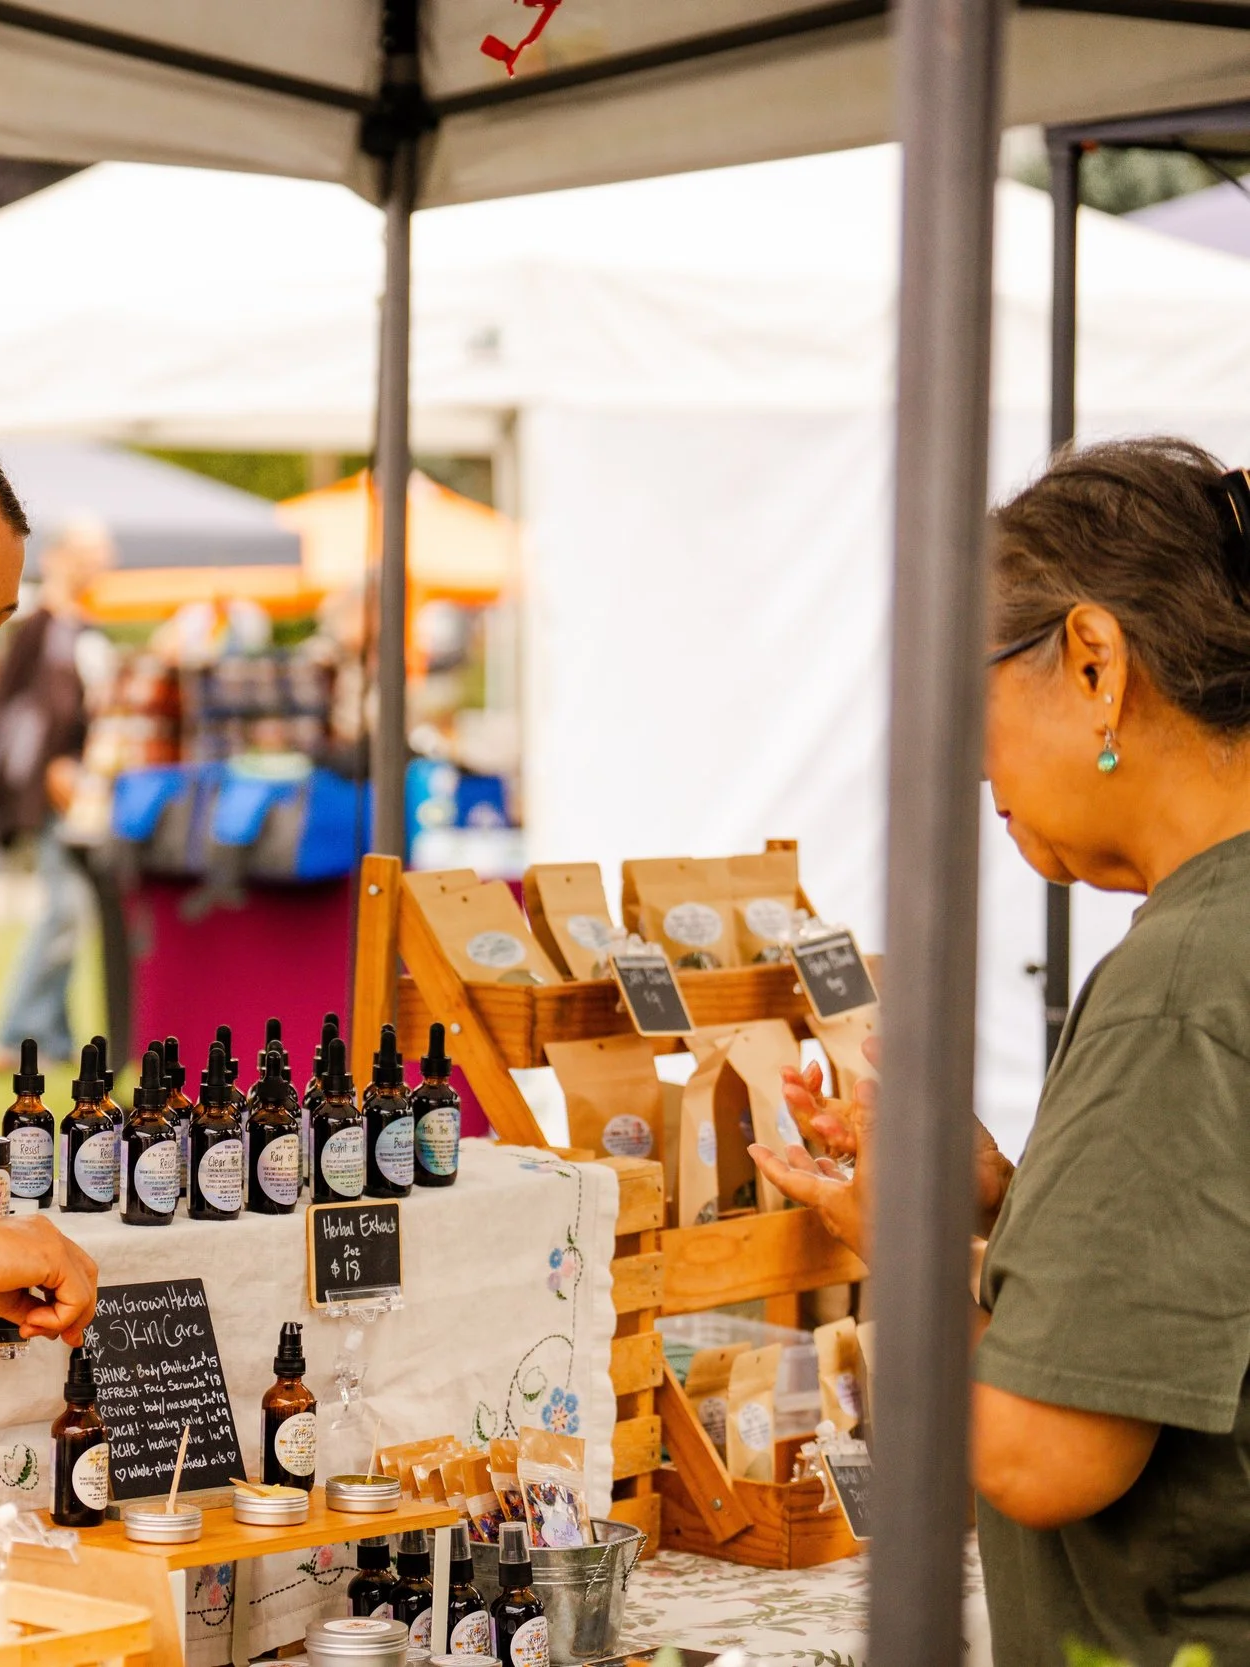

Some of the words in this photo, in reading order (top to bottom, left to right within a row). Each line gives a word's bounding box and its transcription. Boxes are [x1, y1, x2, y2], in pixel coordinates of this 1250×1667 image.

[20, 1144, 40, 1155] Resist
[323, 1215, 355, 1239] Herbal
[343, 1244, 361, 1258] 2oz
[95, 1293, 168, 1317] RM-Grown
[167, 1285, 206, 1311] Herbal
[163, 1314, 205, 1347] Care
[137, 1364, 160, 1381] Body
[144, 1384, 167, 1394] Face
[167, 1380, 195, 1392] Serum
[147, 1419, 180, 1434] healing
[181, 1414, 204, 1427] salve
[147, 1435, 178, 1452] healing
[180, 1433, 205, 1448] alve
[181, 1454, 208, 1471] nfused
[211, 1451, 227, 1465] oils
